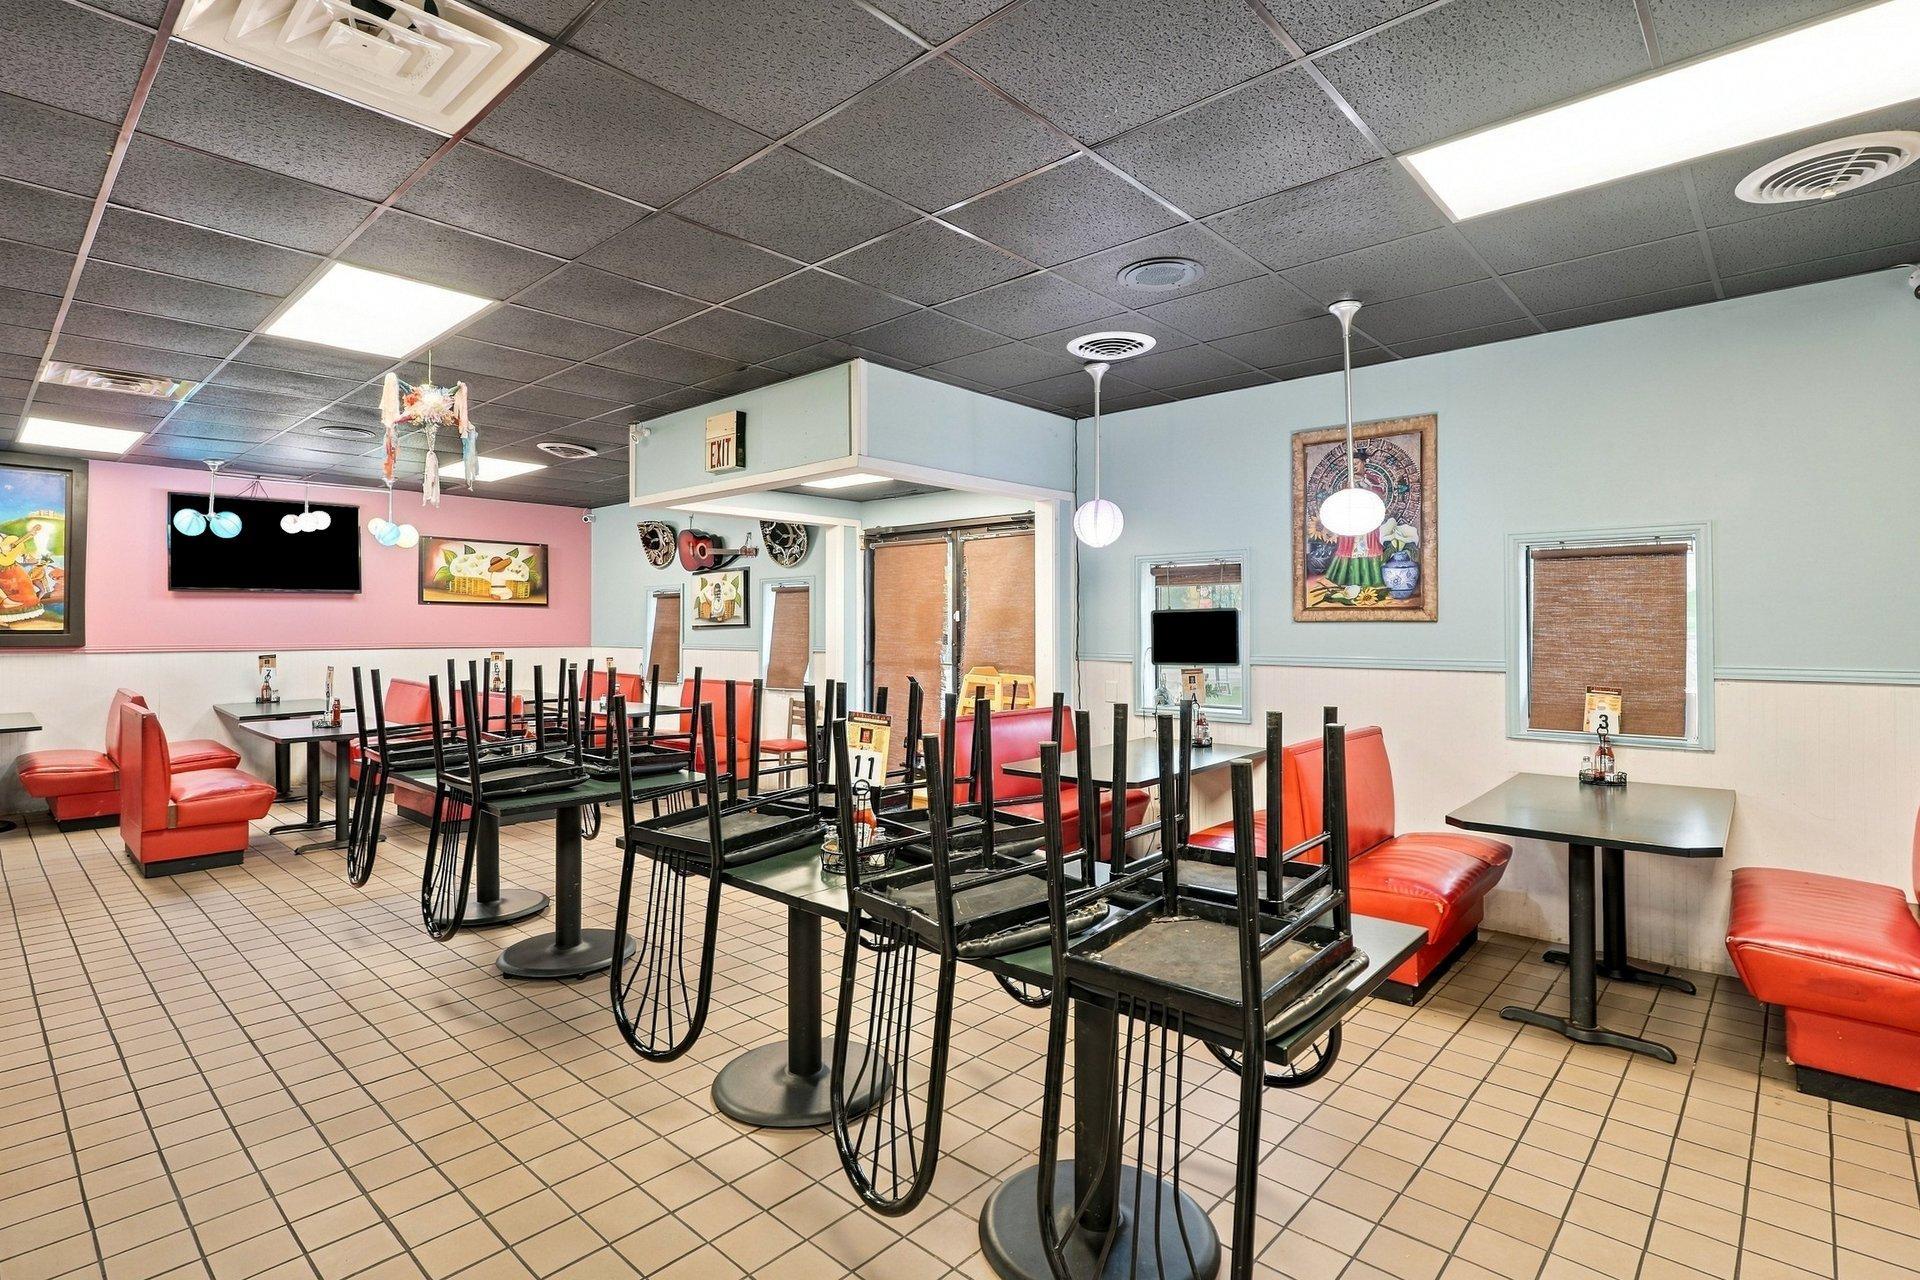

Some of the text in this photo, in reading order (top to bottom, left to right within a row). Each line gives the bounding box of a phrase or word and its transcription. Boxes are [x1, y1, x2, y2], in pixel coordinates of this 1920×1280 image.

[710, 437, 732, 469] EXIT
[1598, 714, 1609, 729] 3
[854, 754, 875, 780] 11
